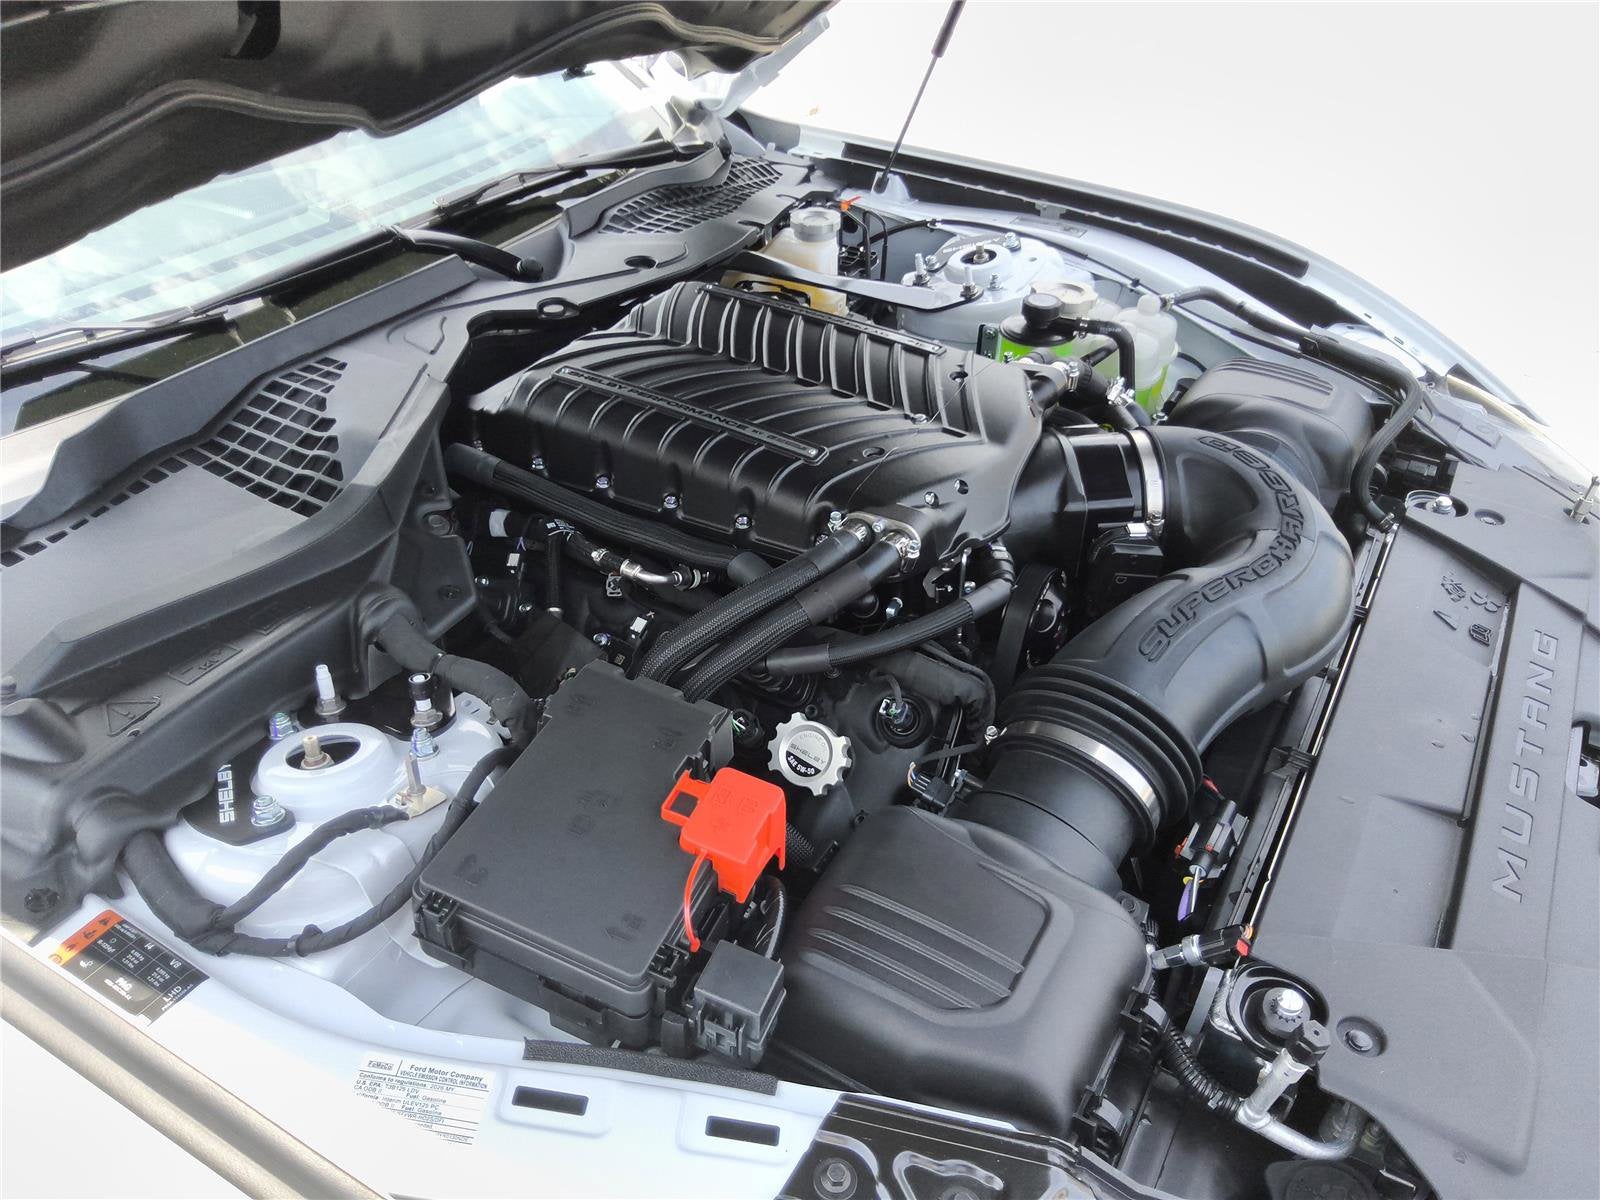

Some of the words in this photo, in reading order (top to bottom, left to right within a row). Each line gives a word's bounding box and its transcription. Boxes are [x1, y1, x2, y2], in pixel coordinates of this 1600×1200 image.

[568, 371, 627, 389] SHELBY
[627, 388, 748, 430] PERFORMANCE
[1139, 436, 1304, 662] SUPERCHARGED
[790, 742, 826, 765] SHELBY
[788, 755, 799, 767] SAE
[796, 762, 815, 774] 5W-50
[1492, 629, 1559, 903] MUSTANG
[162, 986, 182, 1003] LHD
[359, 1072, 387, 1082] Conforms
[400, 1070, 417, 1078] VEHICLE
[418, 1072, 438, 1081] EMISSION
[438, 1075, 458, 1085] CONTROL
[458, 1078, 487, 1089] INFORMATION
[410, 1064, 426, 1073] Ford
[428, 1068, 450, 1076] Motor
[450, 1071, 484, 1082] Company
